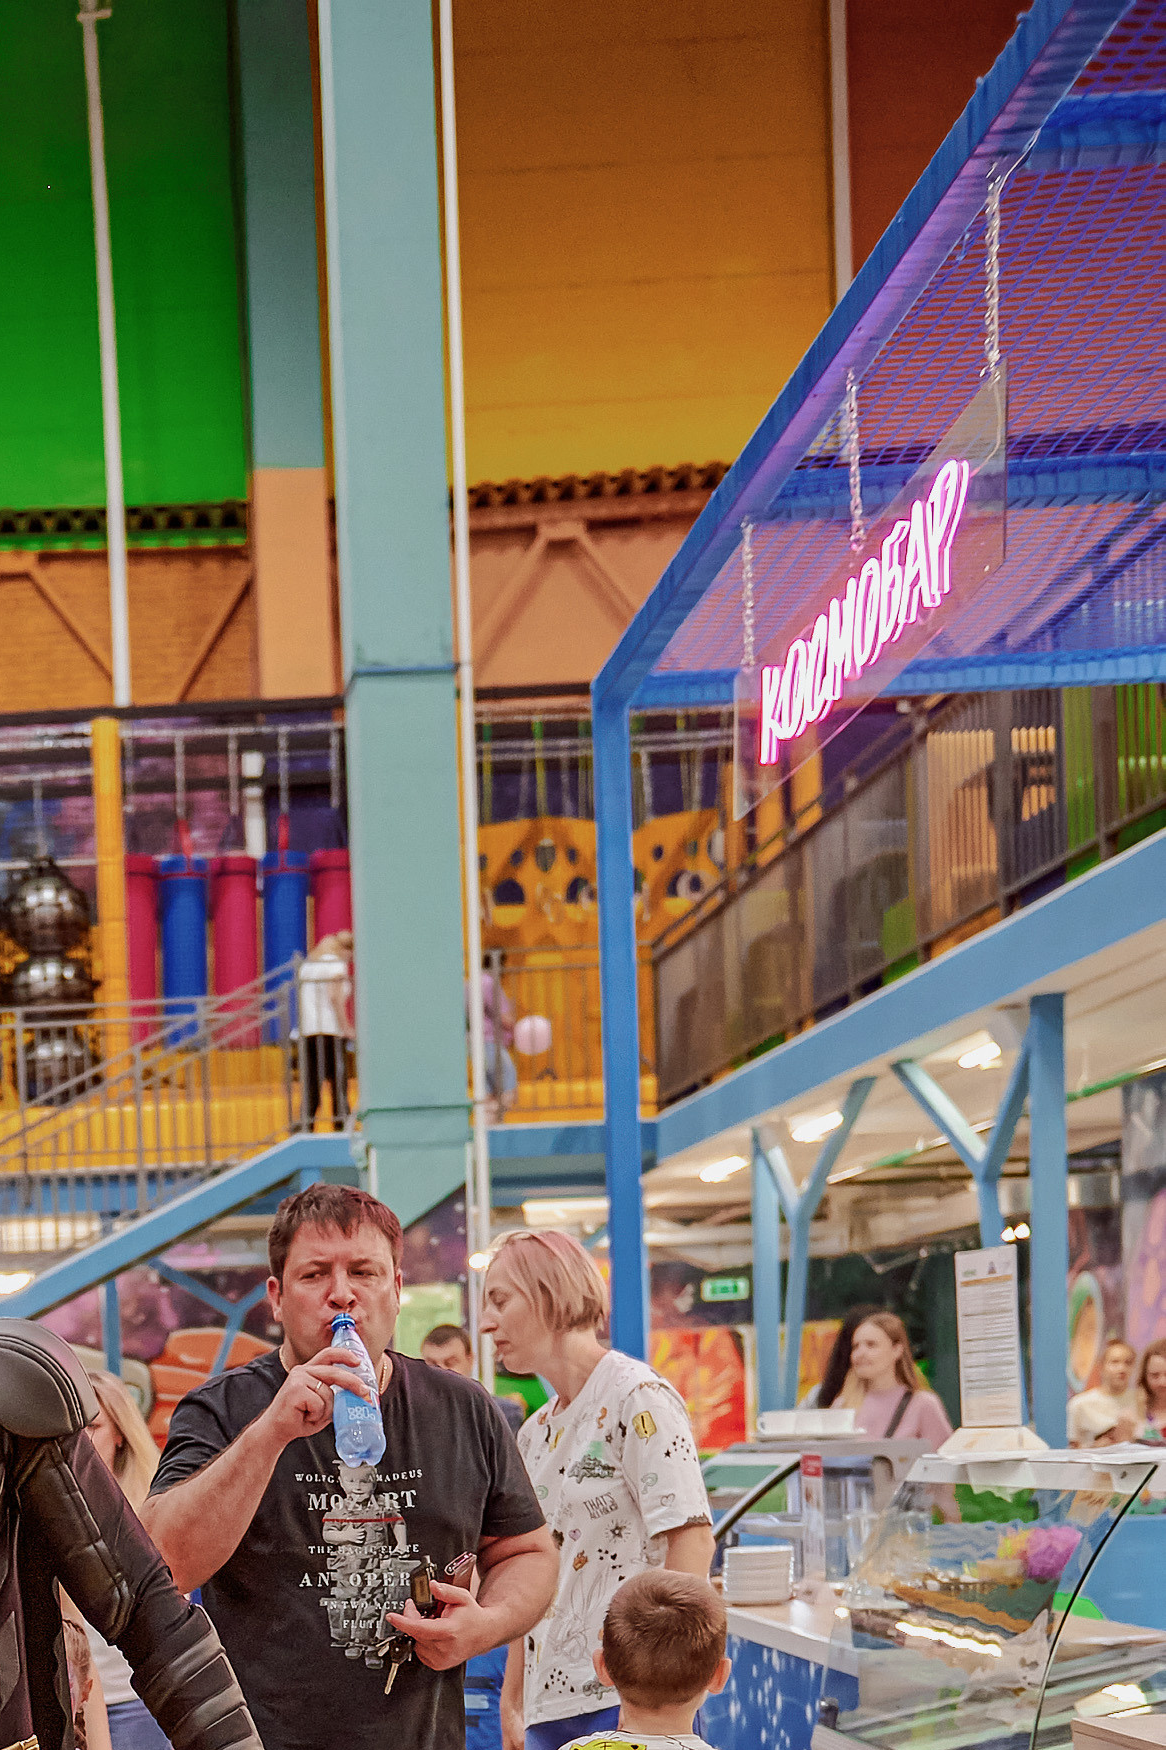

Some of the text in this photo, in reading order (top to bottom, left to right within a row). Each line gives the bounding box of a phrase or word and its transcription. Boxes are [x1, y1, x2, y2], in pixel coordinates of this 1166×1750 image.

[760, 459, 970, 765] КОСМОБАР
[308, 1490, 417, 1511] MOZART
[308, 1546, 334, 1555] THE
[381, 1544, 420, 1554] FLTE
[299, 1571, 411, 1587] AN OPER
[375, 1601, 405, 1609] ACTS
